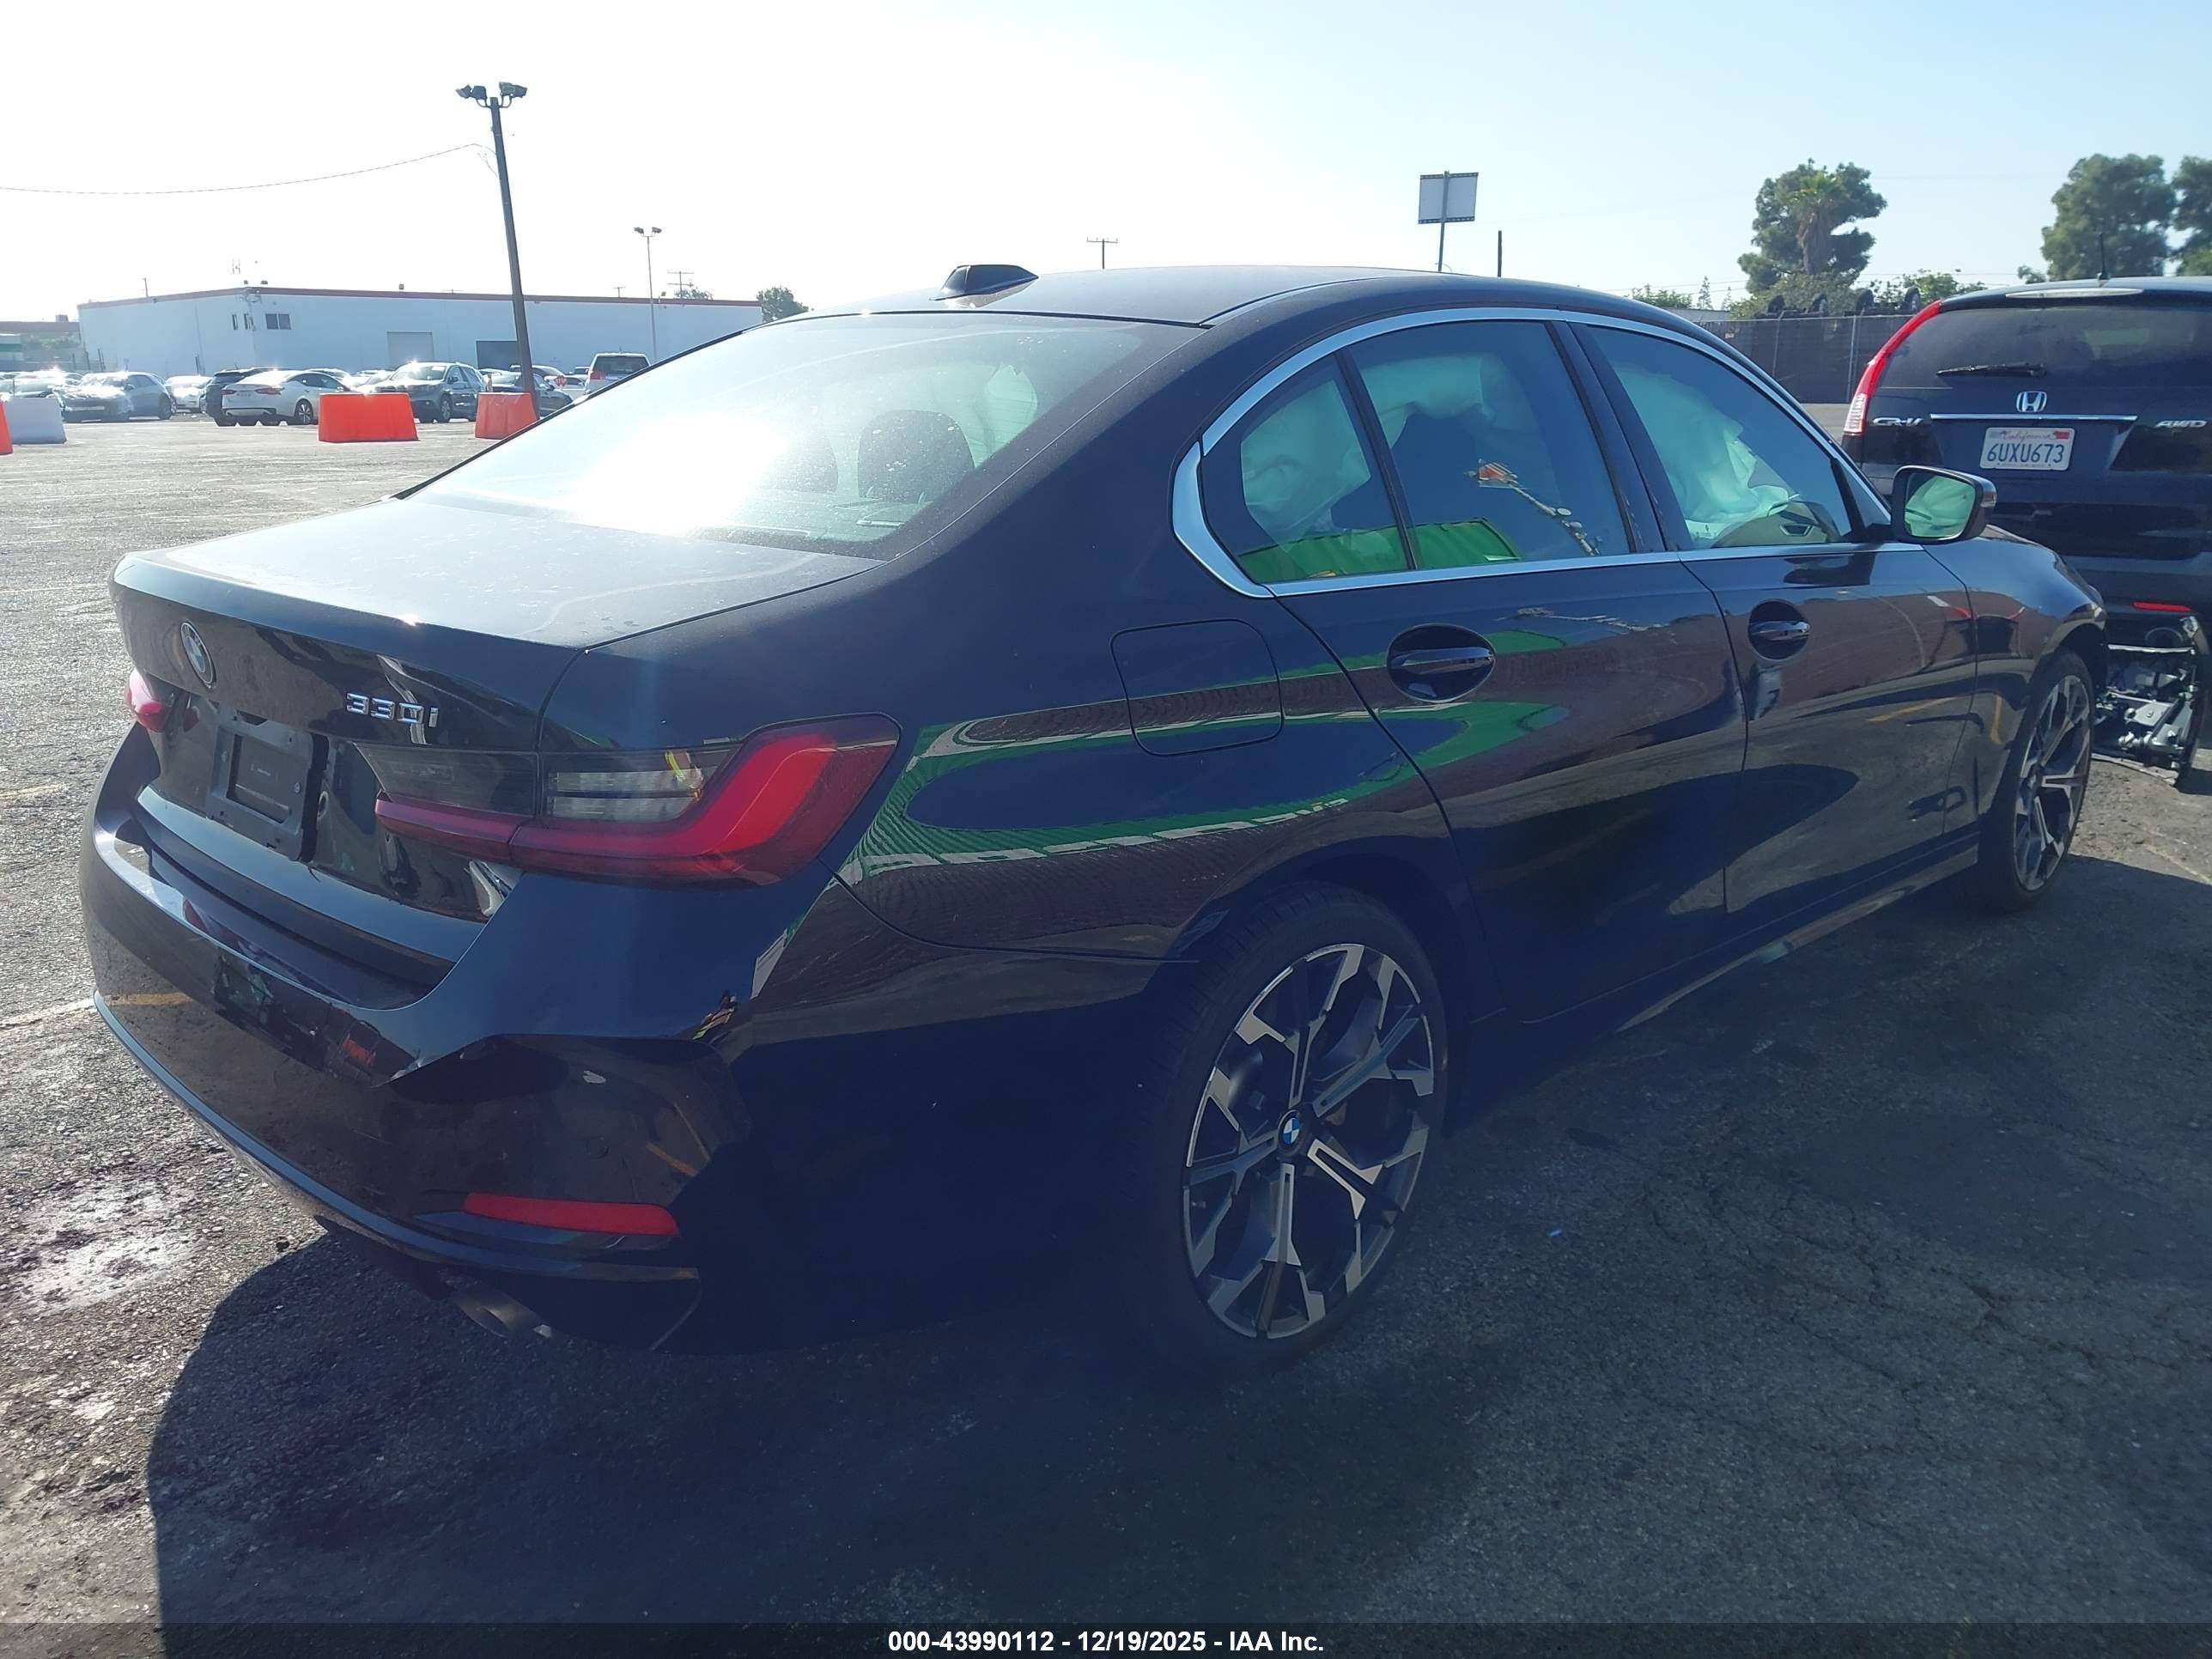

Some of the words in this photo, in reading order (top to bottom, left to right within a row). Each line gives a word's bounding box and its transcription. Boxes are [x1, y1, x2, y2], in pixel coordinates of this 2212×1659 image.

[2155, 420, 2207, 428] AWD
[1986, 442, 2065, 463] 6UXU673
[346, 692, 439, 728] 330i
